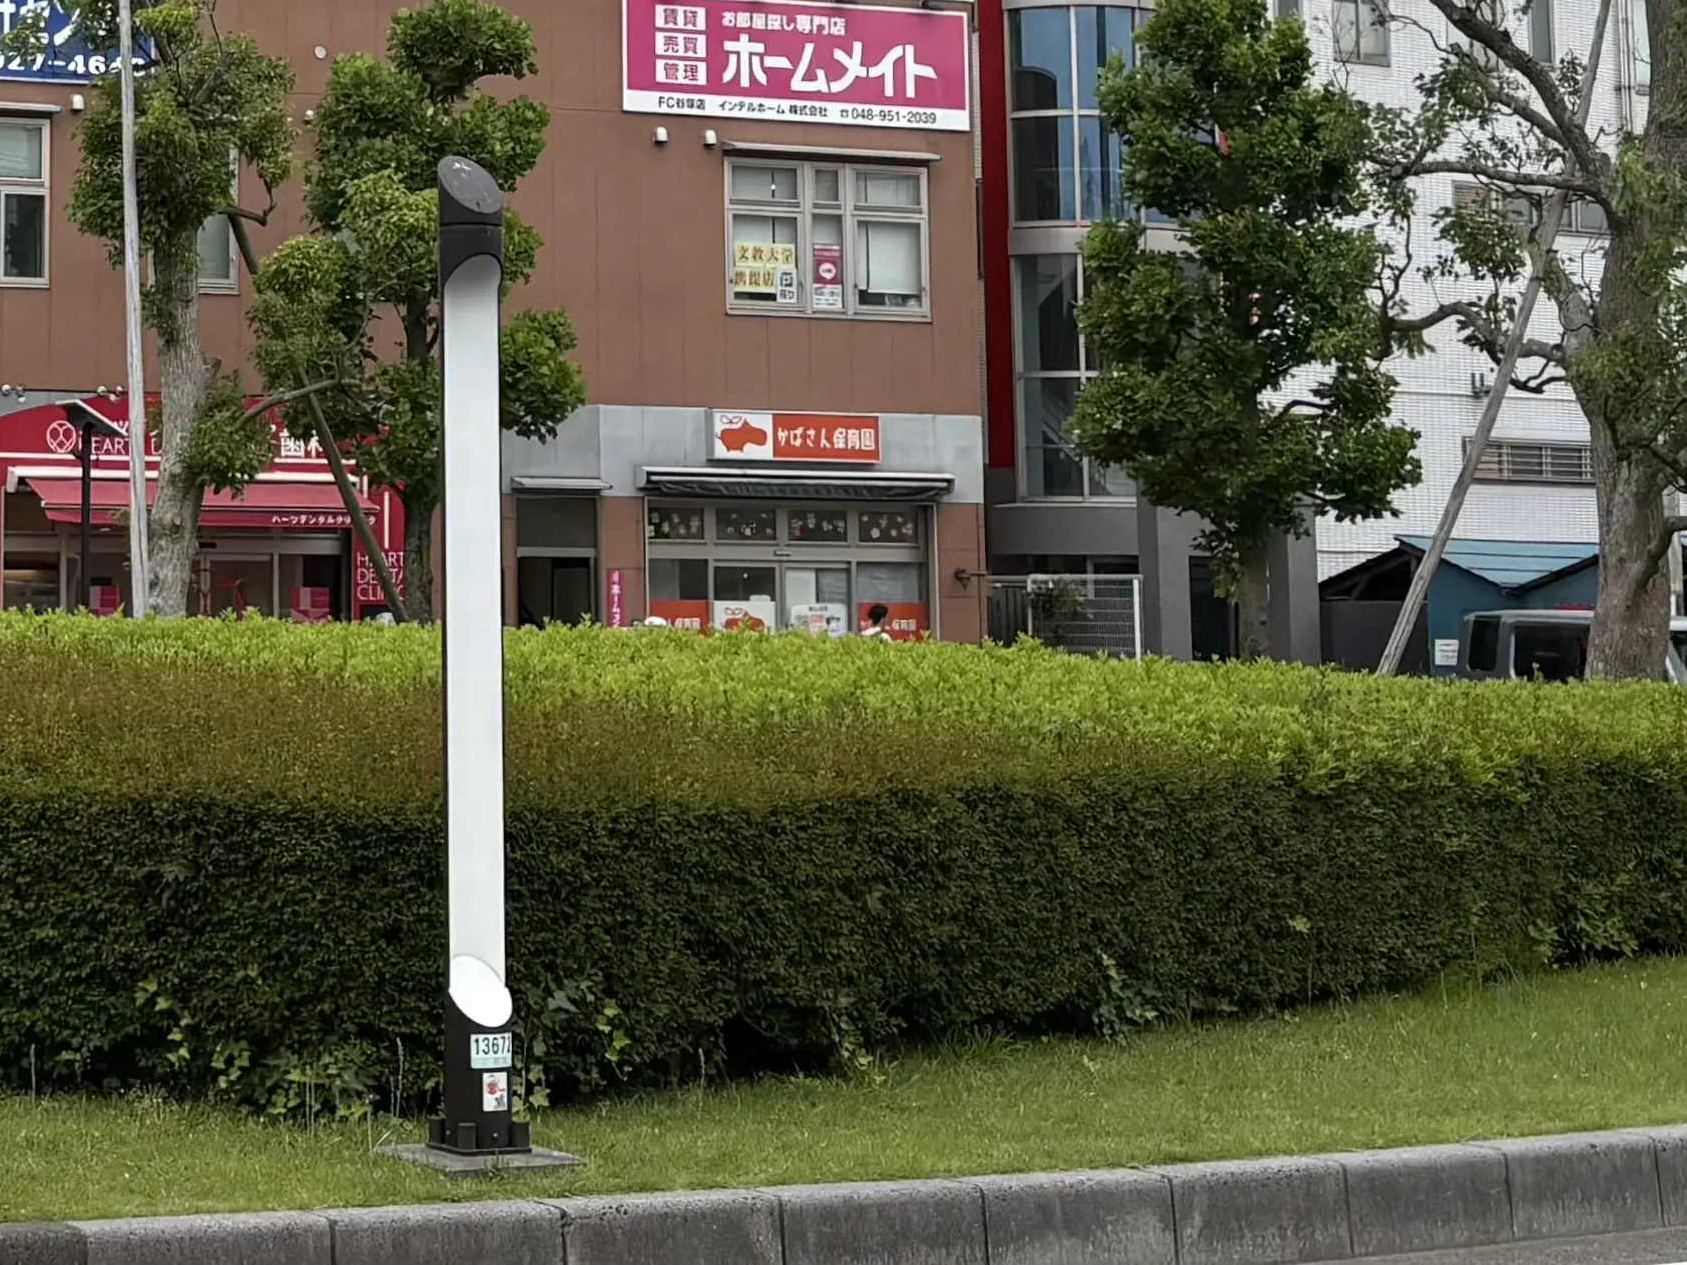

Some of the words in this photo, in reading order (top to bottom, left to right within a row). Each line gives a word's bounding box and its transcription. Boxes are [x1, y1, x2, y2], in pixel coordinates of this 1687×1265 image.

[663, 8, 698, 28] 賃貸
[721, 11, 845, 36] お部屋探し専門店
[663, 35, 698, 54] 売買
[663, 62, 699, 81] 管理
[722, 33, 937, 98] ホームメイト
[851, 108, 937, 125] 048-951-2039
[78, 430, 130, 454] EAR
[777, 426, 875, 451] かばさん保育園
[357, 551, 404, 567] HART
[357, 568, 404, 584] DET
[357, 585, 404, 600] CLIC
